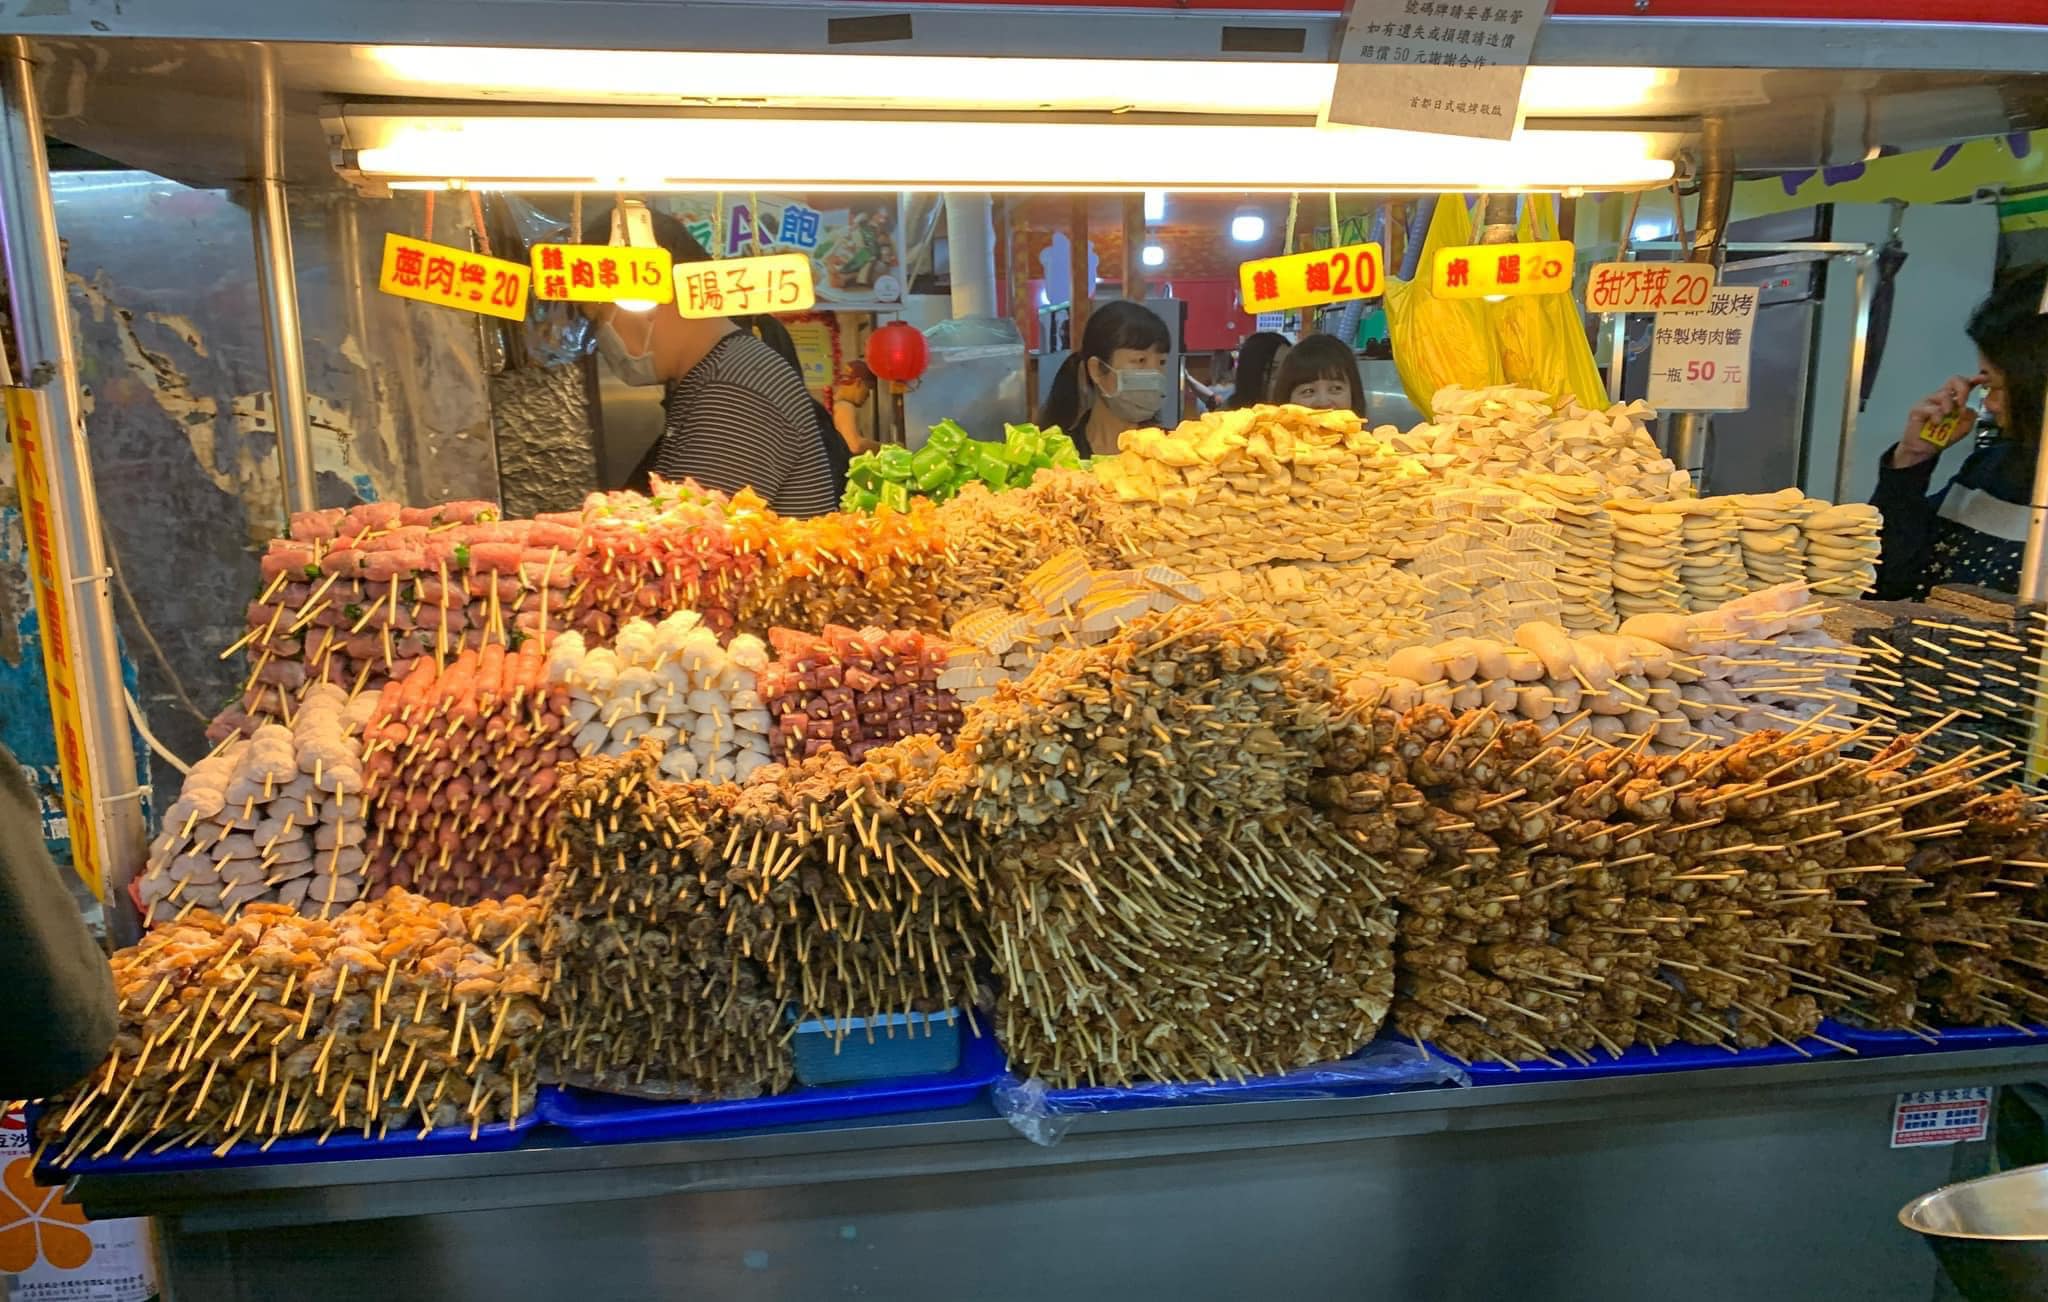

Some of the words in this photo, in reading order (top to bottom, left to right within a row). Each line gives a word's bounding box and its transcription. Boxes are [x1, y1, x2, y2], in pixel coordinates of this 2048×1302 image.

[1656, 328, 1742, 346] 特製烤肉醬
[1686, 360, 1716, 382] 50
[1722, 365, 1743, 384] 元
